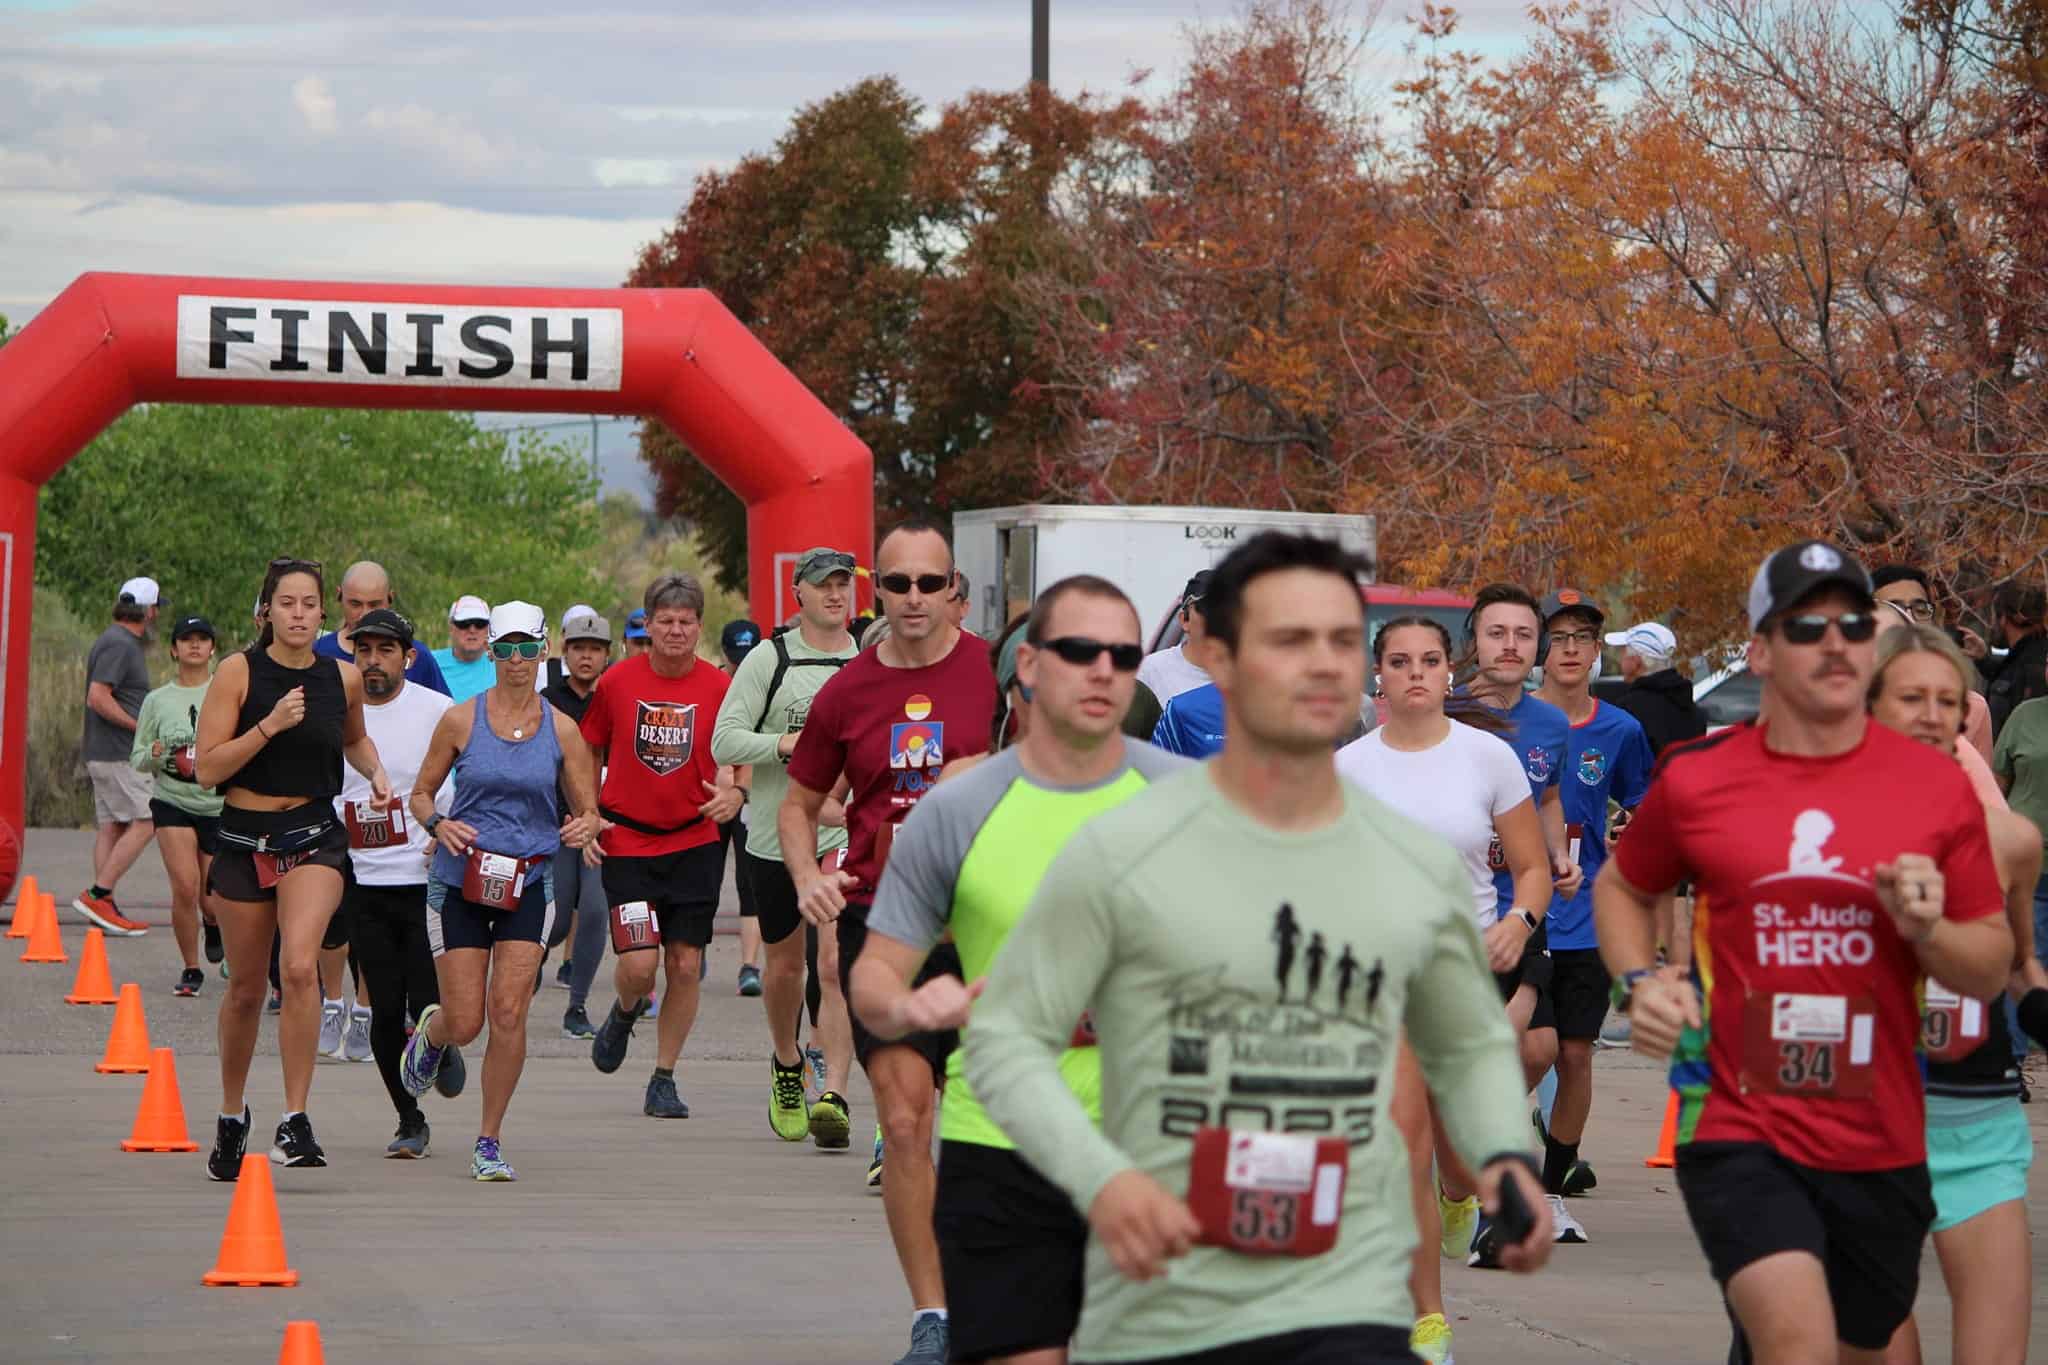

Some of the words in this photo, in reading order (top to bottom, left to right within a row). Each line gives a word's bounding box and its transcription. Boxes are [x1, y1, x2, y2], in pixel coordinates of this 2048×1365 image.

[208, 305, 589, 381] FINISH
[1184, 525, 1237, 539] LOOK
[643, 708, 687, 728] CRAZY
[640, 725, 689, 745] DESERT
[361, 821, 388, 845] 20
[482, 877, 506, 903] 15
[1753, 902, 1796, 928] St.
[1800, 903, 1874, 928] Jude
[627, 921, 647, 944] 17
[1755, 930, 1875, 967] HERO
[1779, 1041, 1836, 1089] 34
[1161, 1098, 1376, 1148] 2023
[1231, 1188, 1298, 1247] 53
